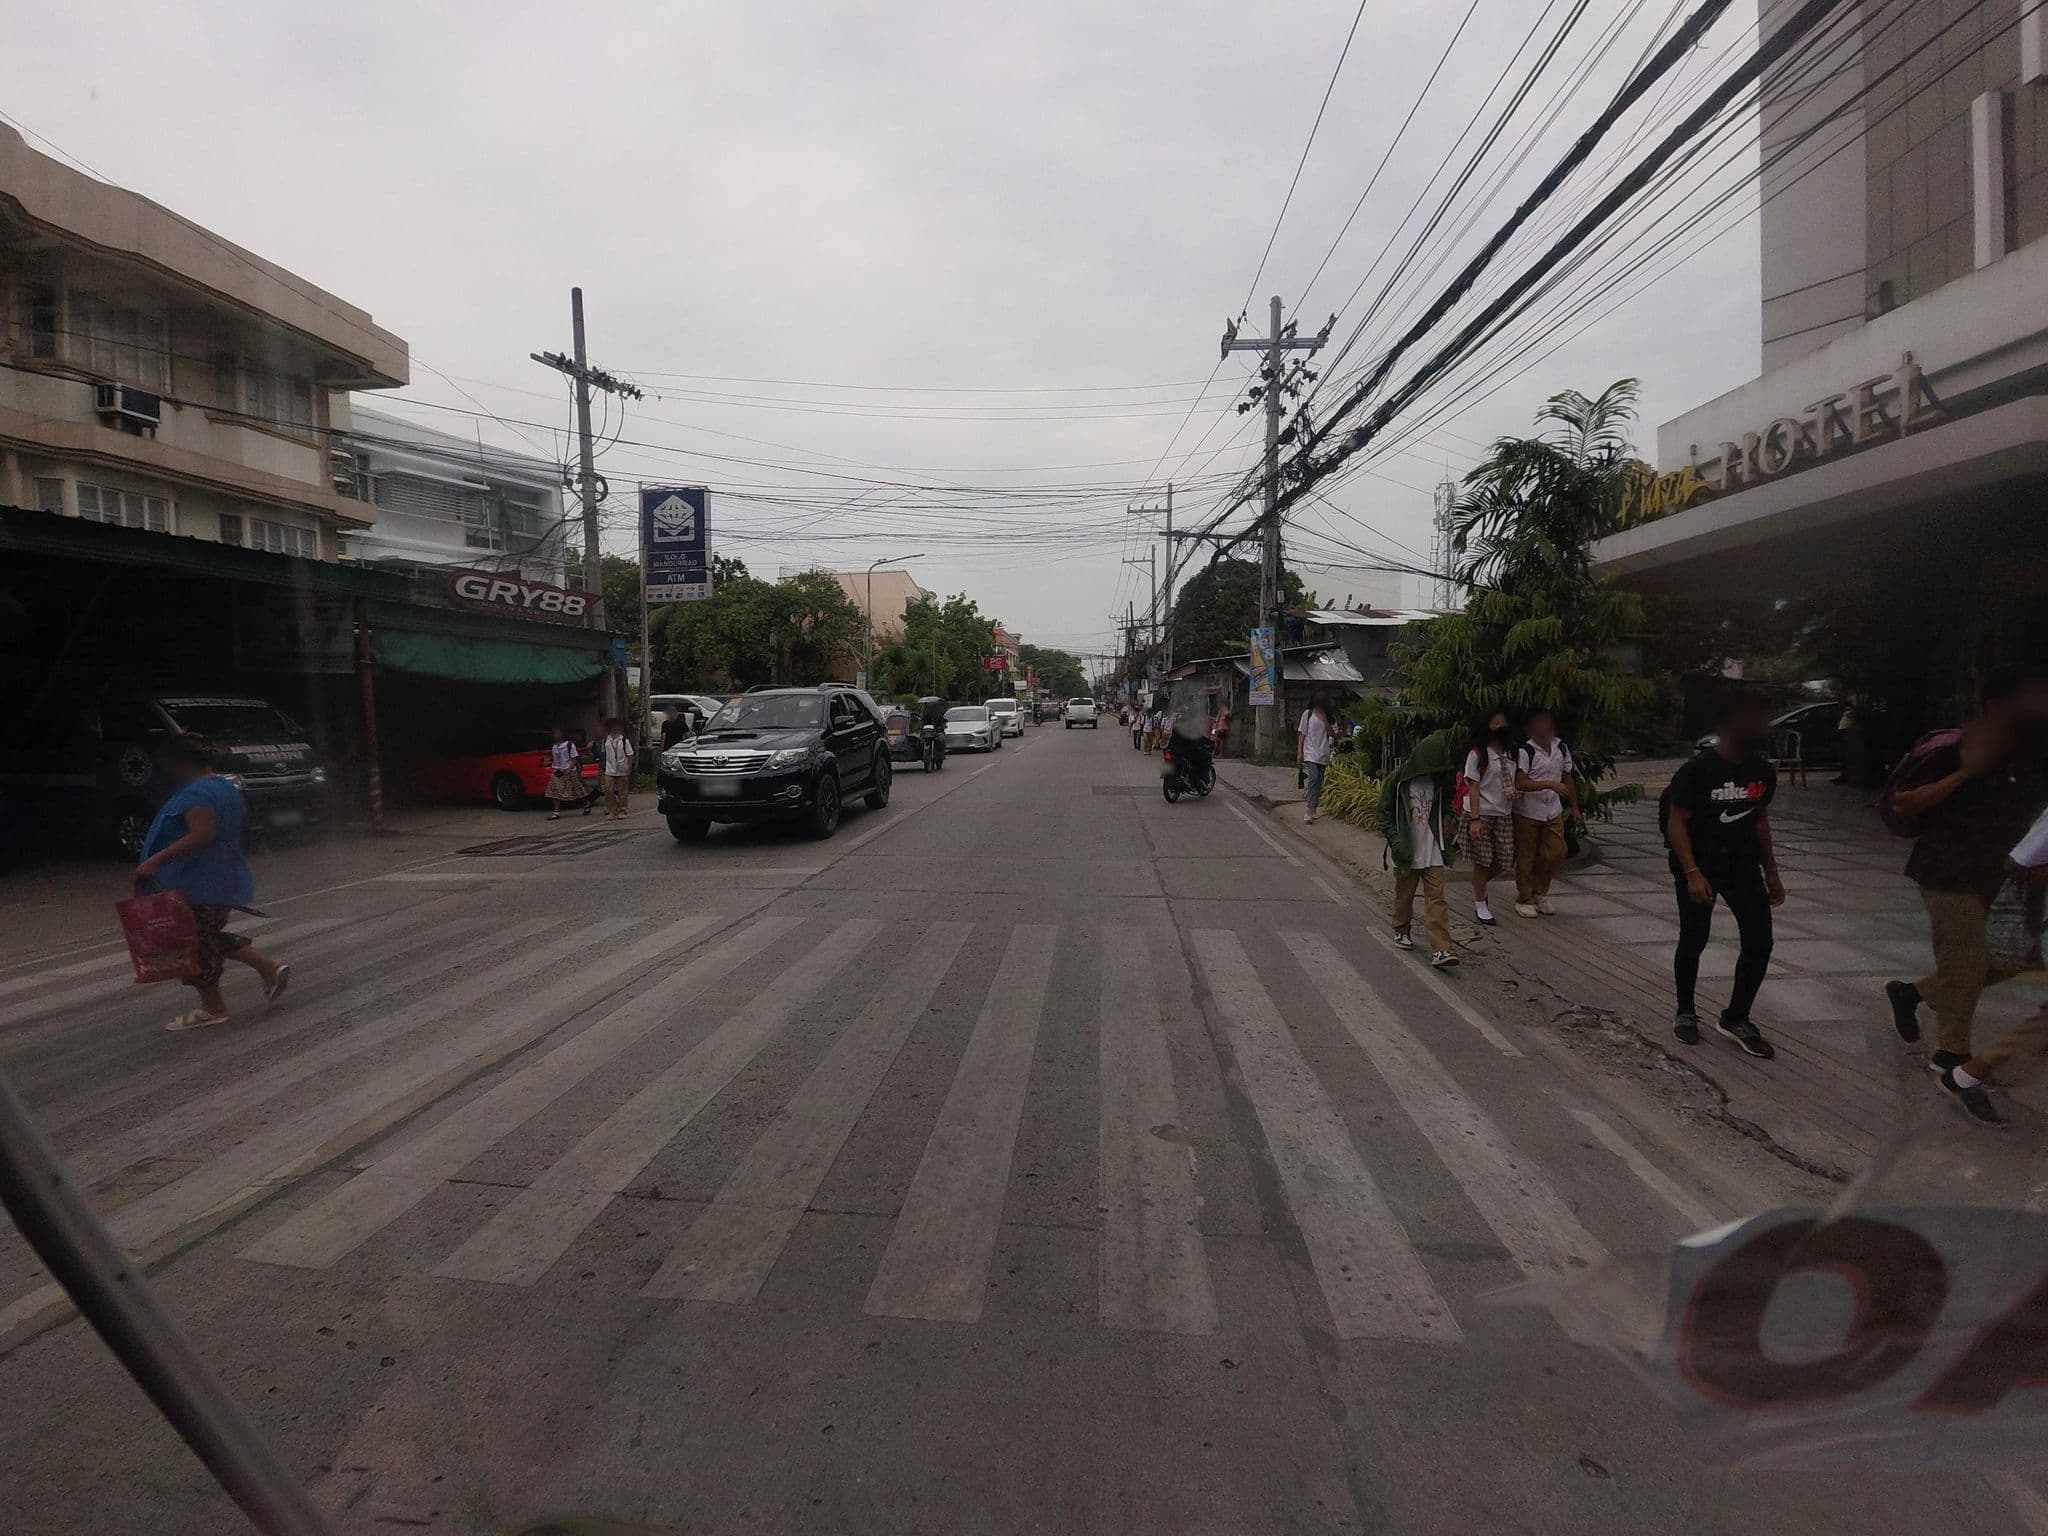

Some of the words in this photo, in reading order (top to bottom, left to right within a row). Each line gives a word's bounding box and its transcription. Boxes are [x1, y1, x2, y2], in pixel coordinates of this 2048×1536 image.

[1718, 364, 1939, 490] HOTEL
[454, 574, 586, 616] GRY88
[667, 573, 686, 583] ATM
